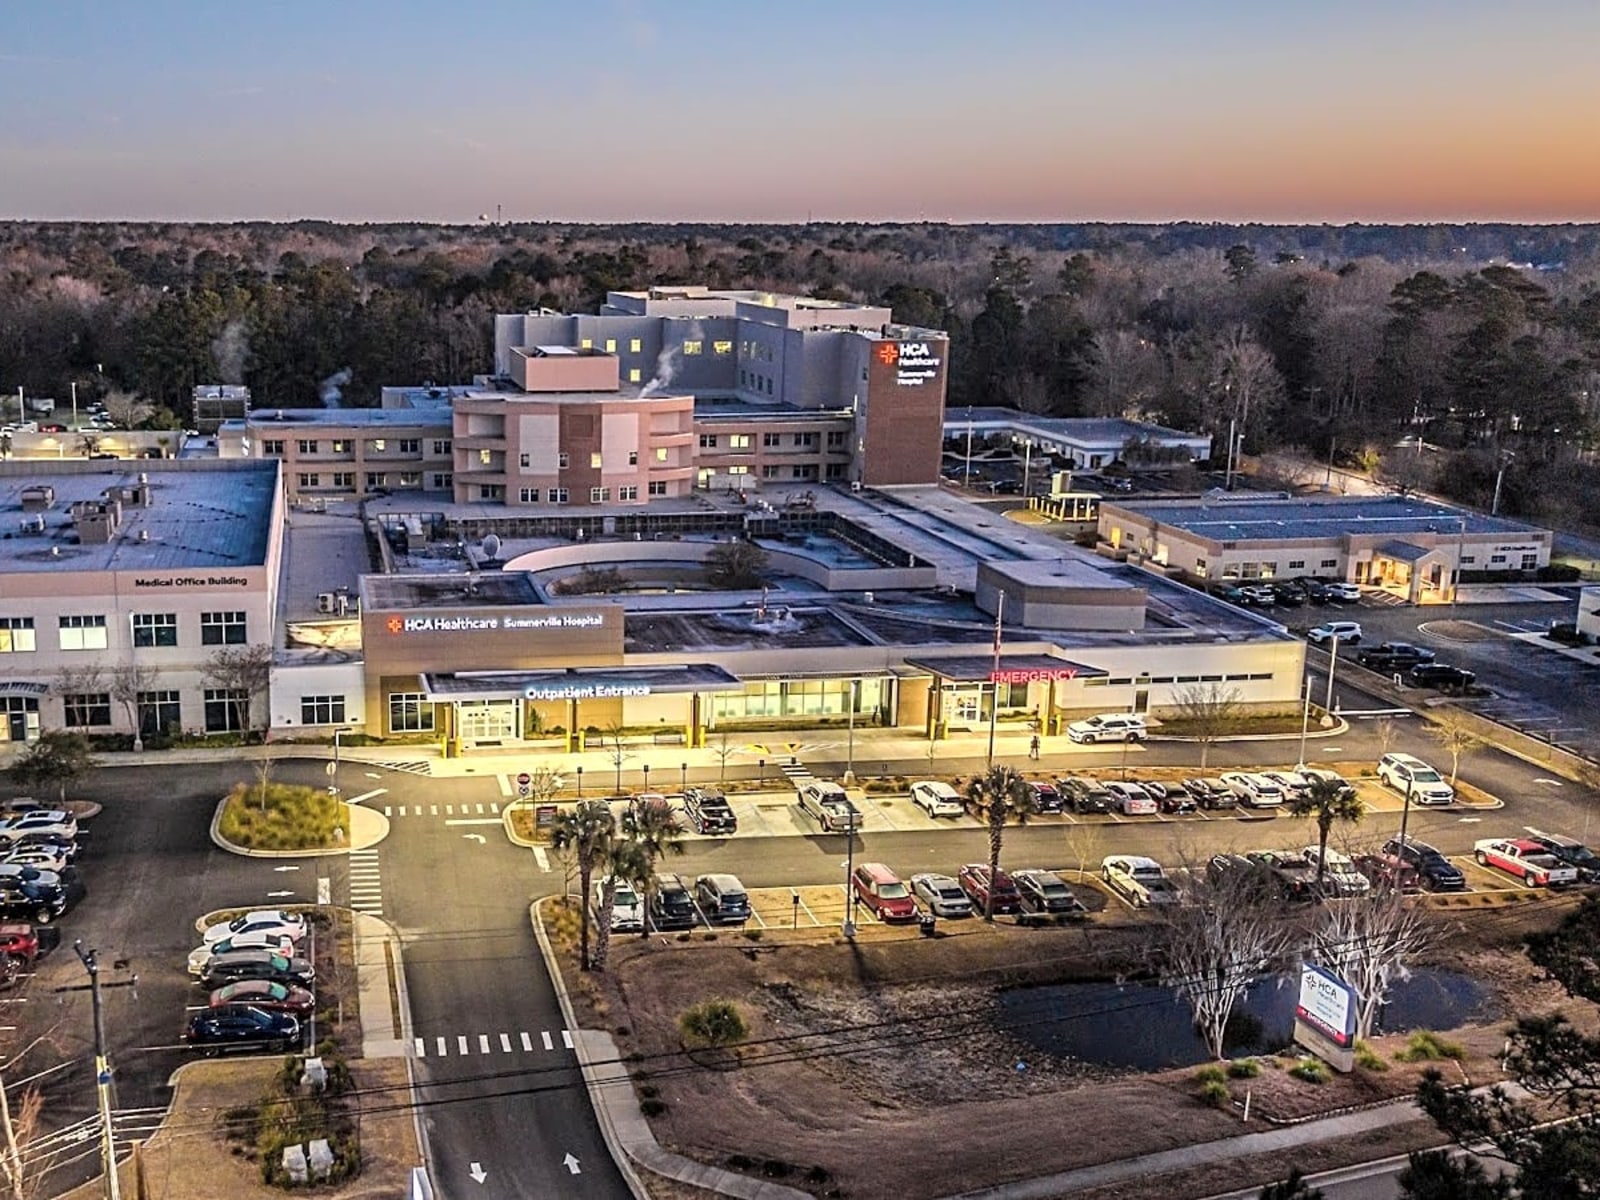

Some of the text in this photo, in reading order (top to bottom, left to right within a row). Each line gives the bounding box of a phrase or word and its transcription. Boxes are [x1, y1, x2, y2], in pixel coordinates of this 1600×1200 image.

[899, 343, 929, 356] HCA
[135, 576, 248, 587] Medical Office Building
[404, 615, 603, 631] HCA Healthcare Summerville Hospital
[991, 669, 1077, 683] EMERGENCY
[525, 685, 651, 700] Outpatient Entrance
[1318, 979, 1337, 999] HCA
